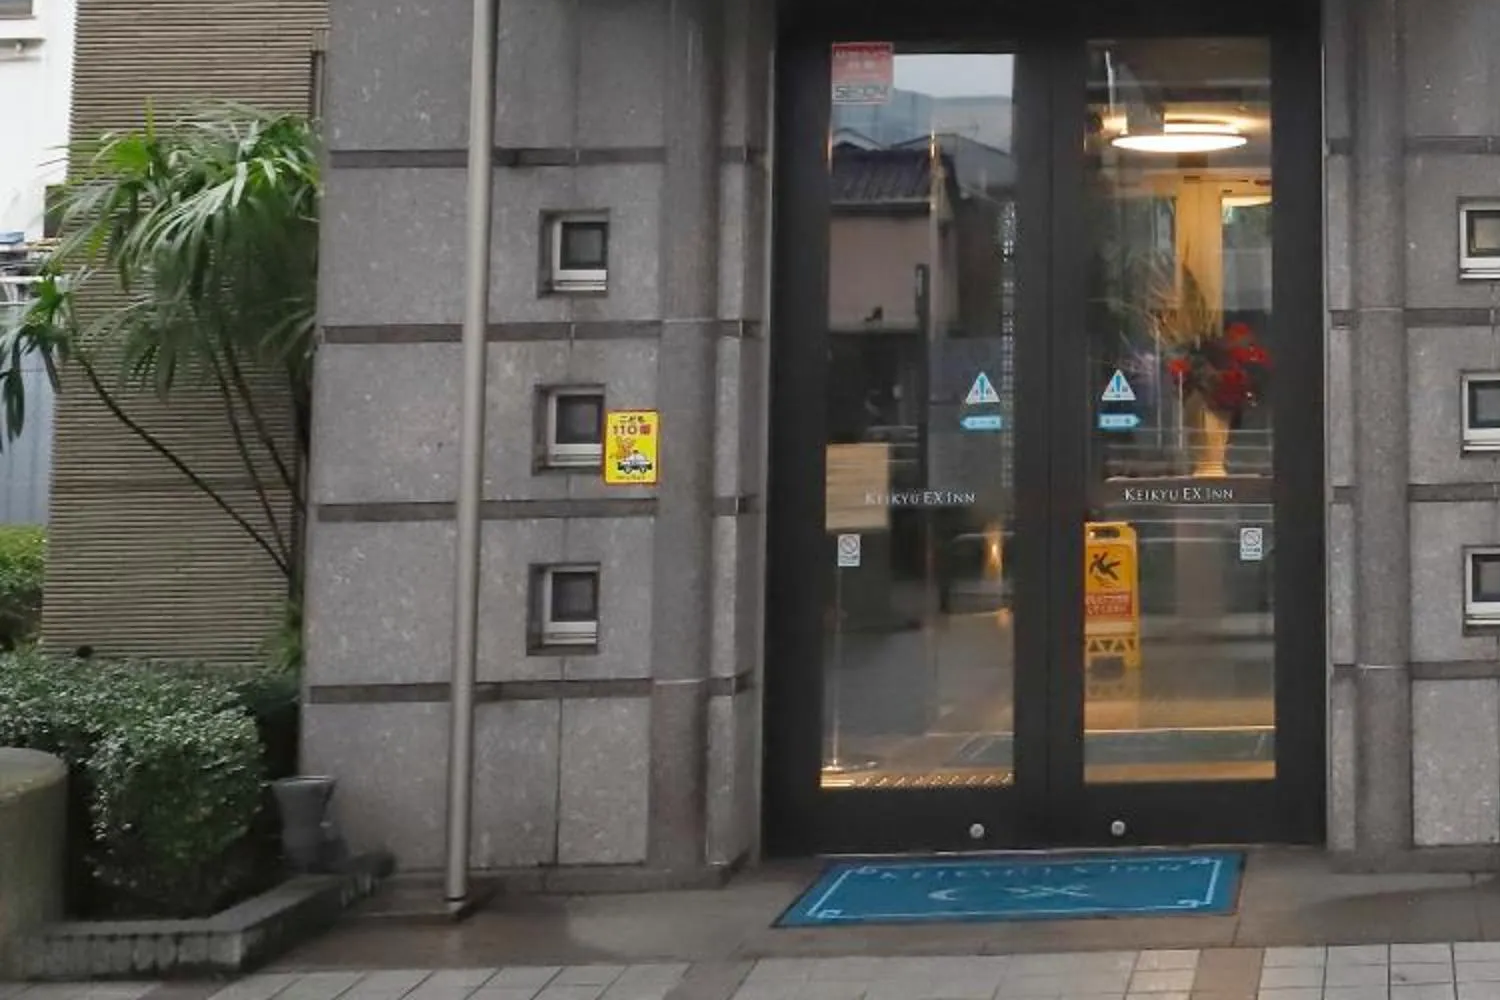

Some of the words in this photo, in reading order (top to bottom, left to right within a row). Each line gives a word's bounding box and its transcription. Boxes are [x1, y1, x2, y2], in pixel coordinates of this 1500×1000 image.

[923, 490, 944, 505] EX
[947, 490, 977, 504] INN
[1124, 487, 1179, 502] KEIKYU
[1182, 486, 1202, 501] EX
[1205, 487, 1234, 500] INN
